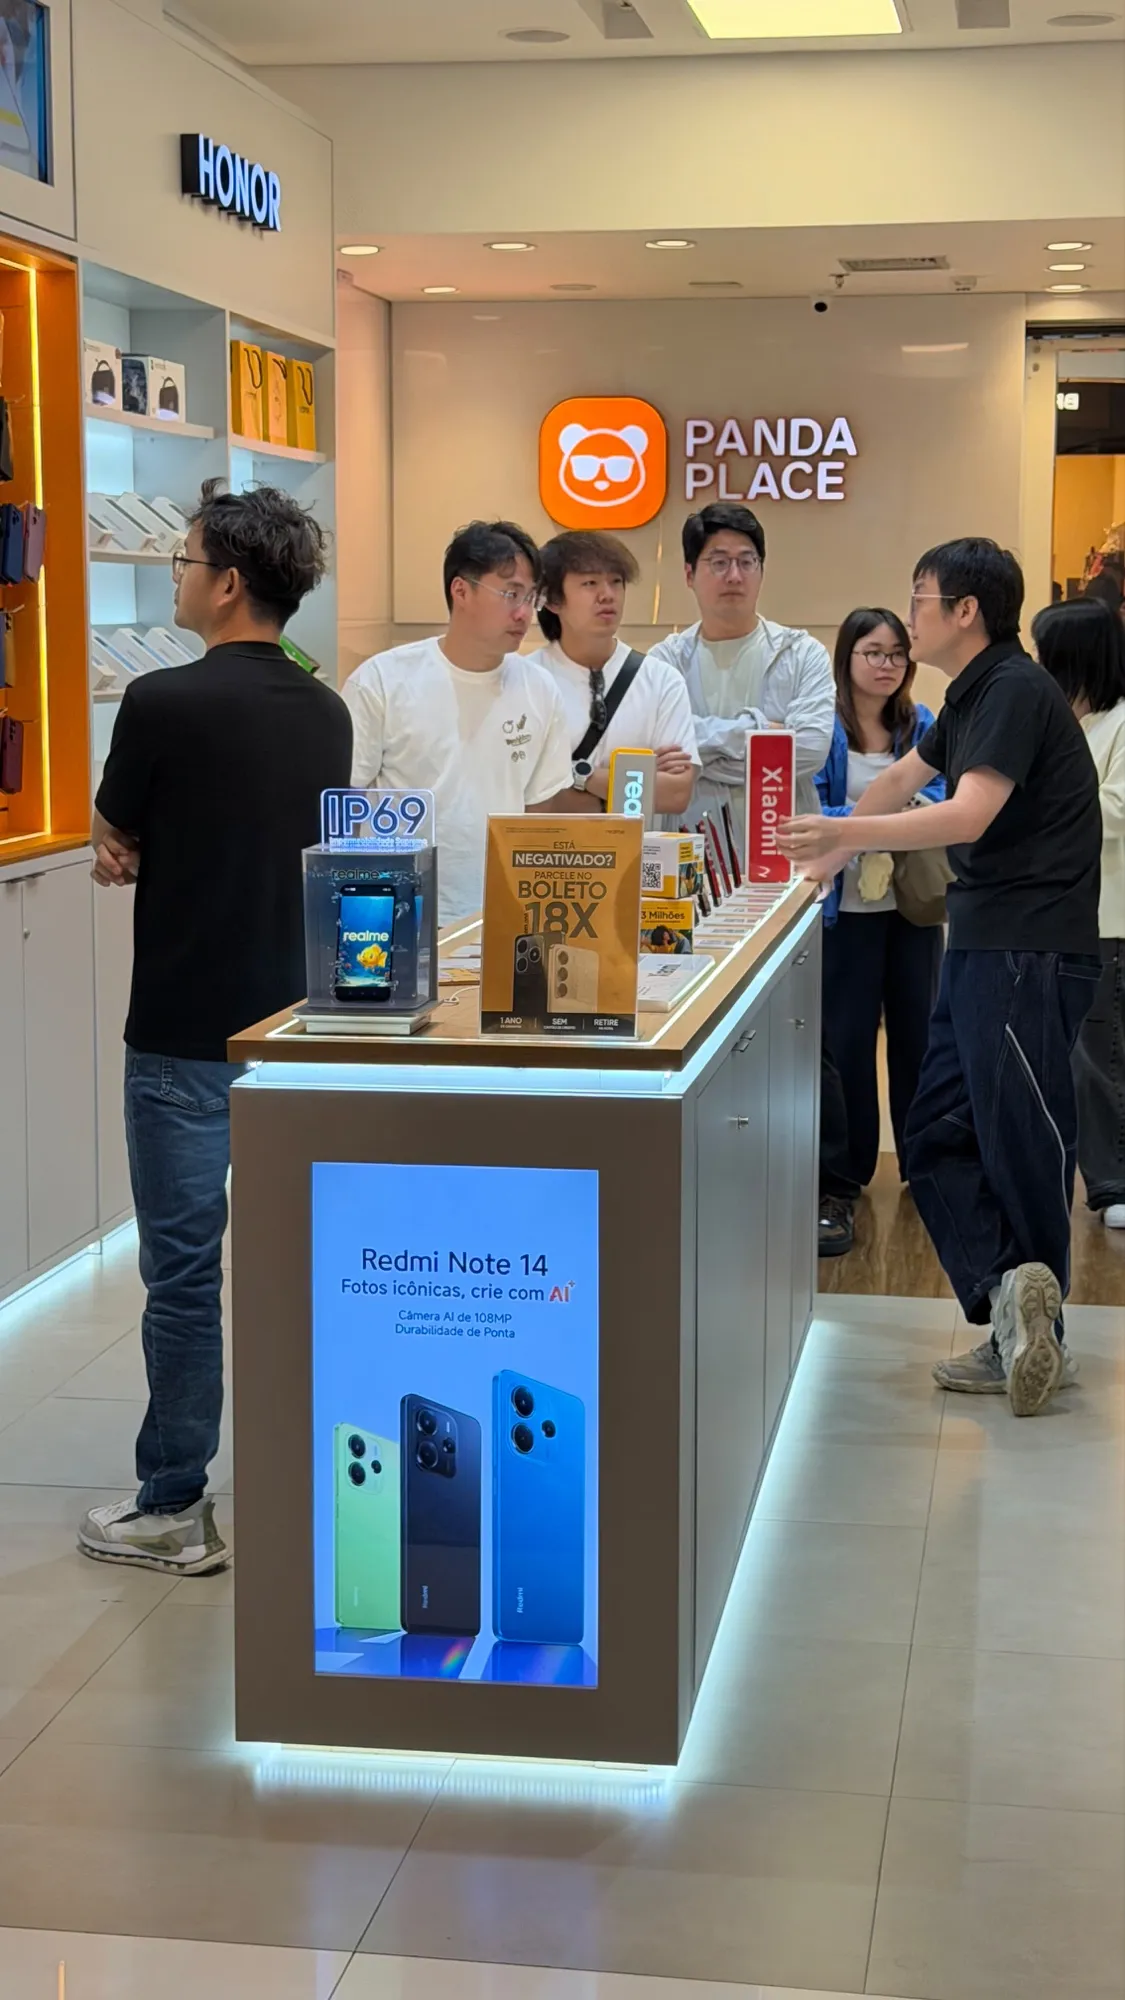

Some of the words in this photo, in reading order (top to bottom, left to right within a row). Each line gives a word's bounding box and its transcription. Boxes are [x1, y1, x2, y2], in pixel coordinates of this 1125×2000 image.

[198, 132, 281, 232] HONOR
[685, 417, 858, 457] PANDA
[685, 461, 846, 500] PLACE
[623, 770, 643, 817] rea
[328, 794, 428, 836] IP69
[760, 766, 784, 857] Xiaomi
[553, 840, 576, 850] ESTÁ
[515, 853, 613, 866] NEGATIVADO?
[331, 868, 380, 881] realme
[534, 871, 575, 880] PARCELE
[577, 872, 592, 880] NO
[518, 880, 607, 900] BOLETO
[525, 901, 600, 939] 18X
[648, 910, 685, 920] Milhões
[343, 930, 390, 942] realme
[362, 1248, 439, 1273] Redmi
[449, 1251, 511, 1275] Note
[520, 1254, 549, 1276] 14
[341, 1279, 388, 1295] Fotos
[393, 1281, 465, 1300] icônicas,
[471, 1283, 503, 1299] crie
[508, 1288, 544, 1301] com
[398, 1309, 440, 1322] Câmera
[443, 1312, 454, 1321] AI
[457, 1312, 471, 1323] de
[474, 1313, 512, 1324] 108MP
[395, 1324, 463, 1337] Durabilidade
[467, 1327, 481, 1338] de
[484, 1327, 515, 1338] Ponta
